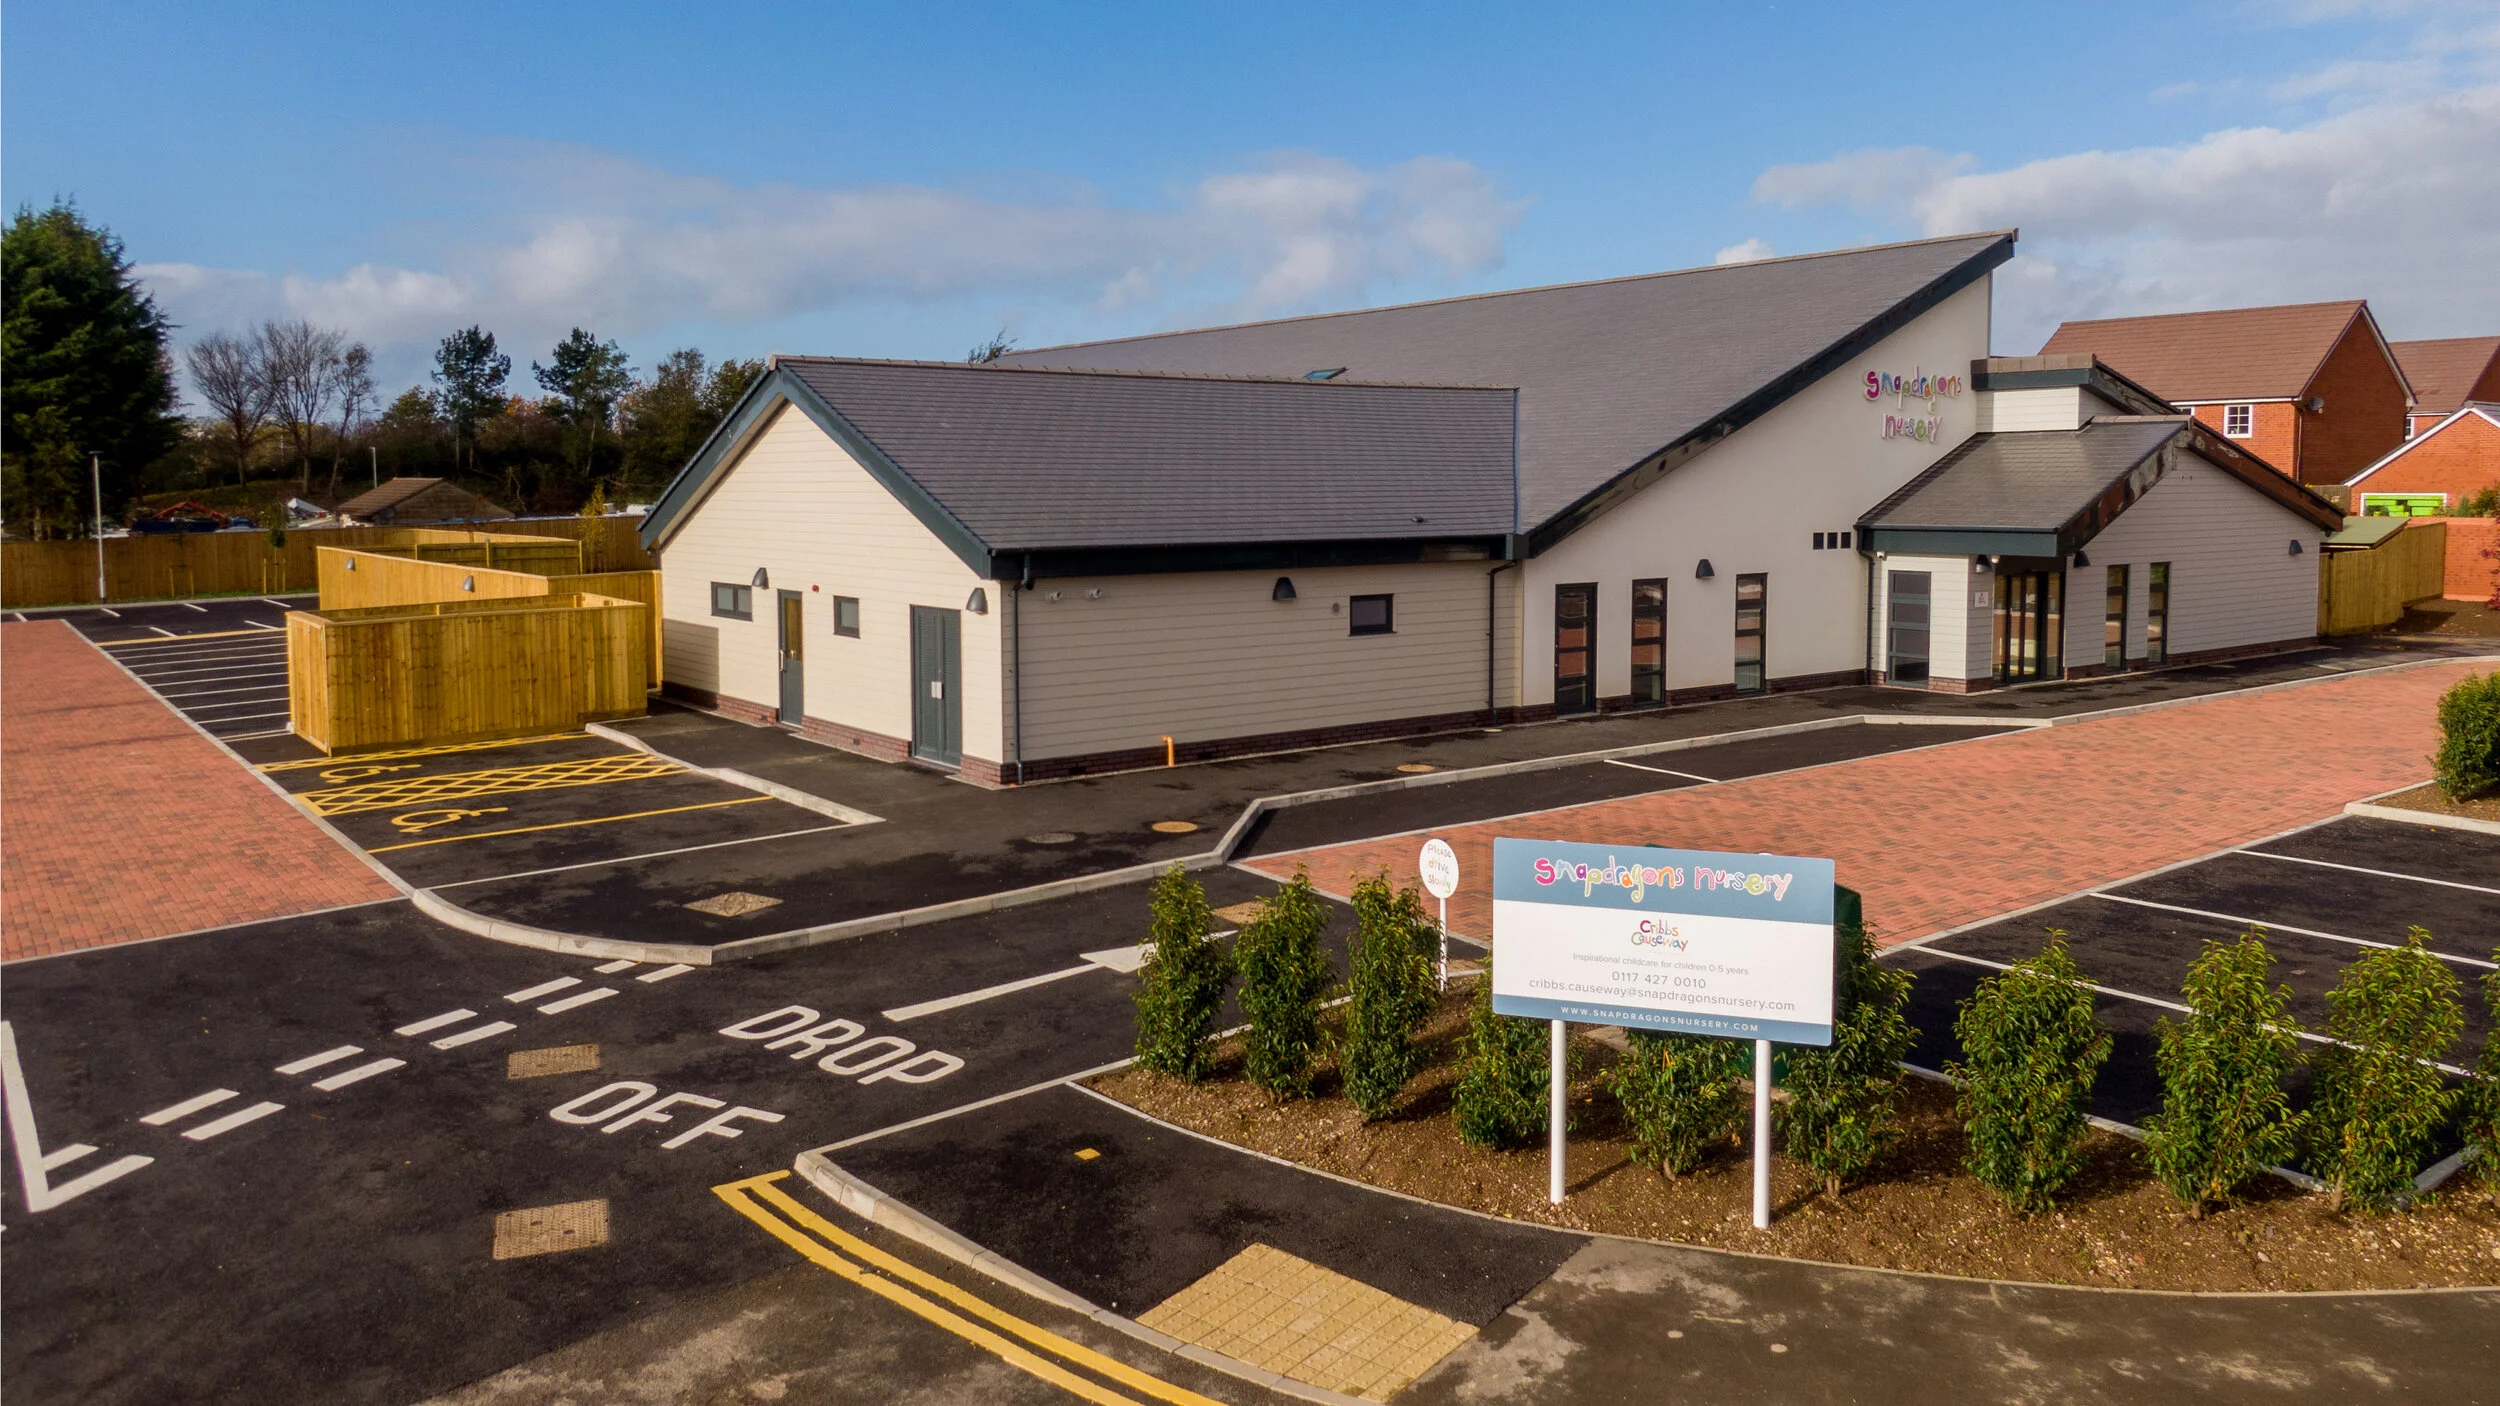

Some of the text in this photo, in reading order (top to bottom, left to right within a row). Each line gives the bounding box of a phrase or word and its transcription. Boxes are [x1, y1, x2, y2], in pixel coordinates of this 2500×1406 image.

[1534, 855, 1793, 903] Snapdragons nursery
[1639, 919, 1679, 937] Cribbs
[1631, 931, 1689, 952] Causeway
[1573, 953, 1749, 976] Inspirational childcare for children 0-5 years
[1611, 971, 1706, 988] 0117 427 0010
[1529, 978, 1795, 1011] cribbs.causeway@snapdragonsnursery.com
[1560, 1006, 1758, 1032] WWW.SNAPDRAGONSNURSERY.COM
[718, 1004, 966, 1086] DROP
[549, 1081, 786, 1150] OFF
